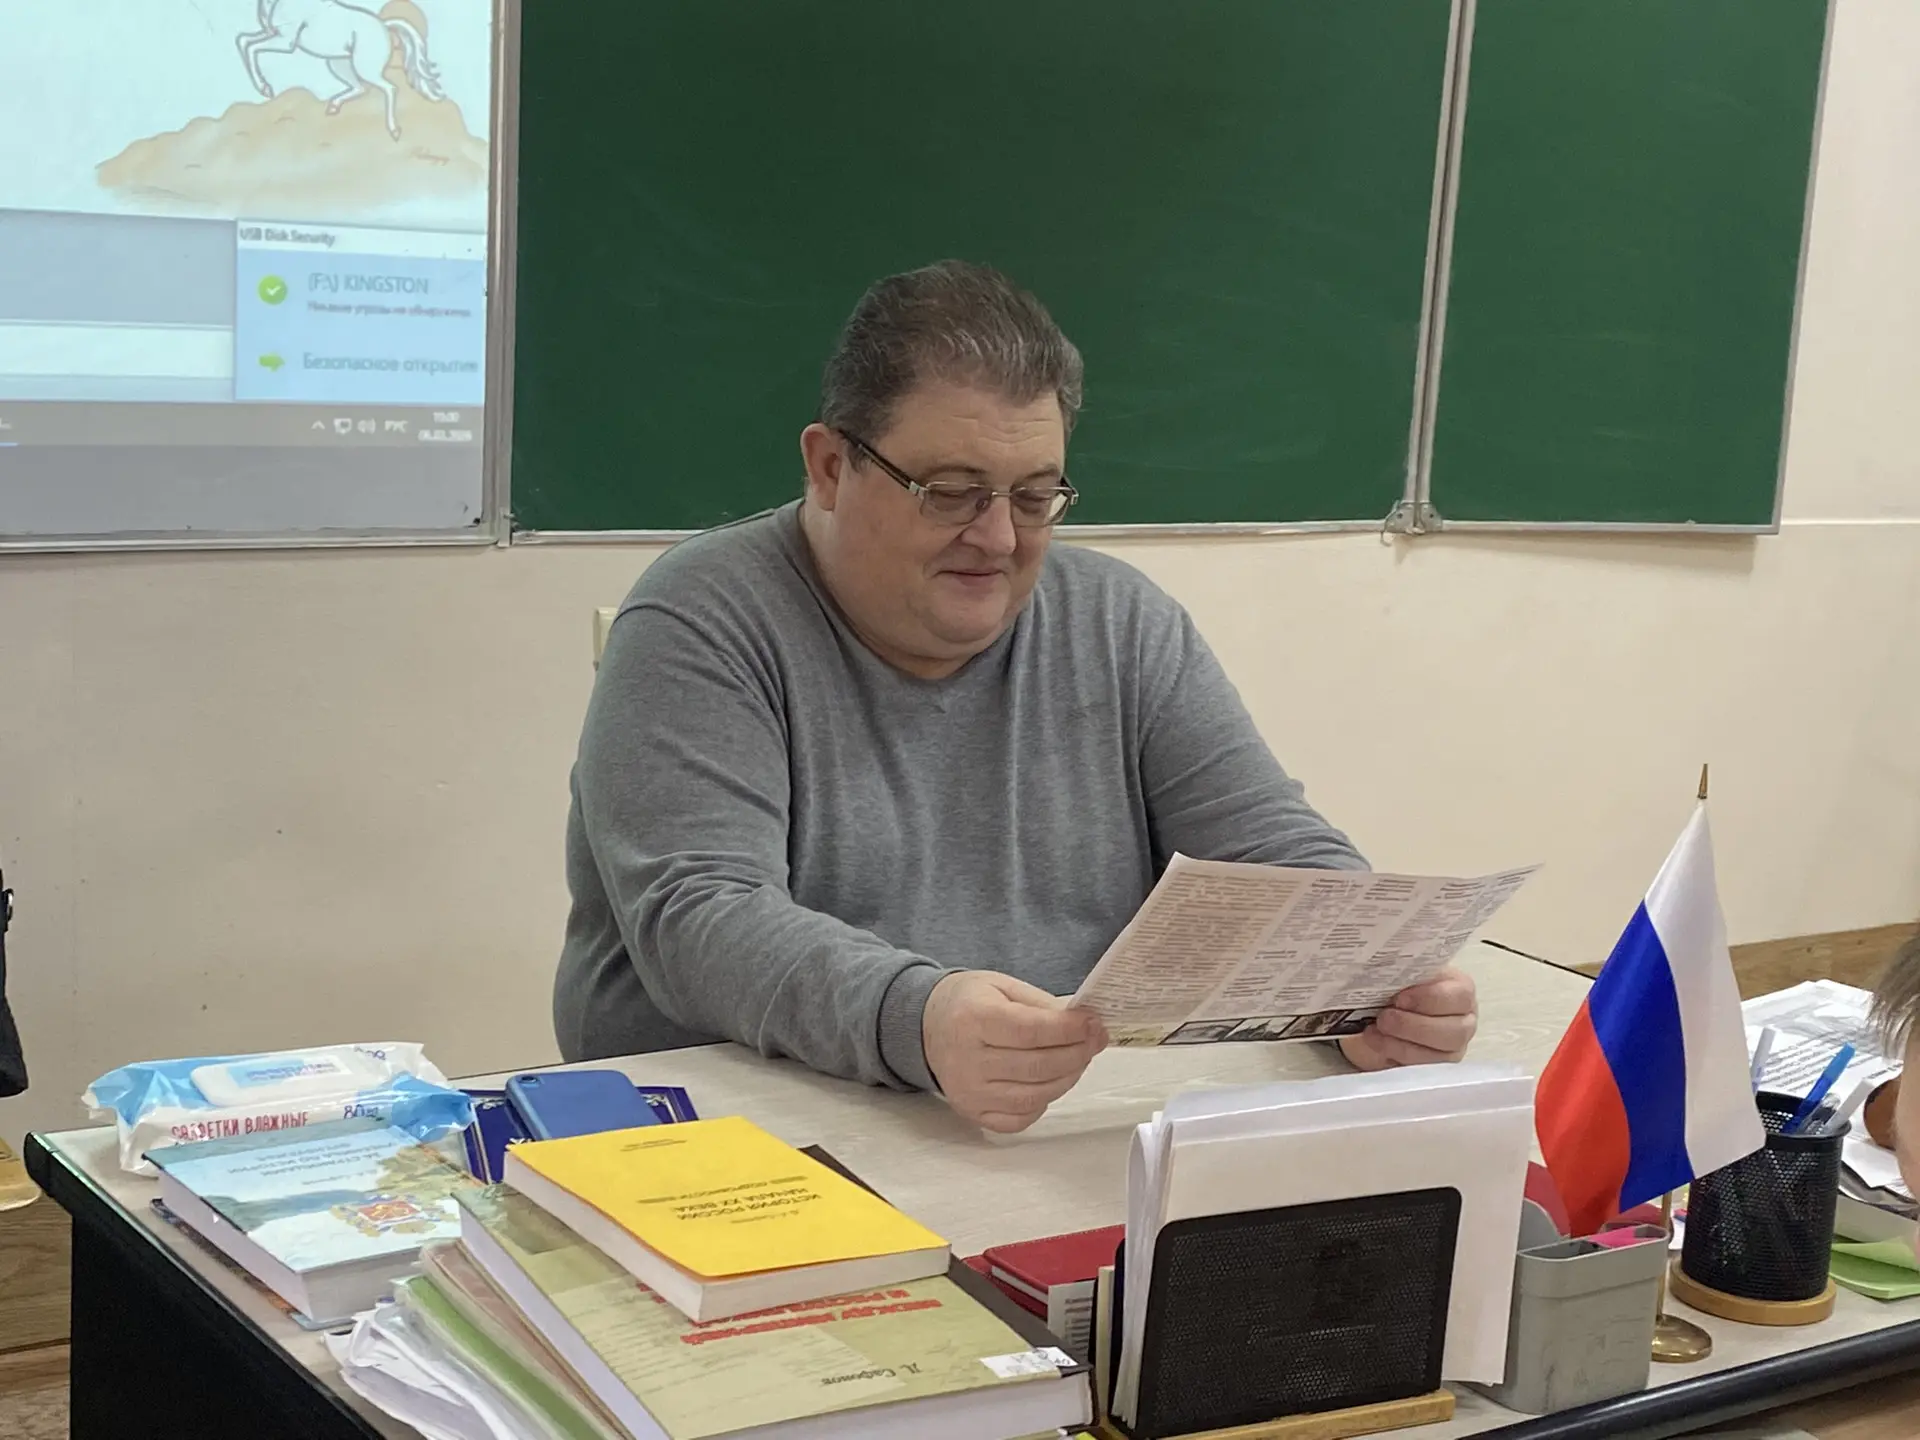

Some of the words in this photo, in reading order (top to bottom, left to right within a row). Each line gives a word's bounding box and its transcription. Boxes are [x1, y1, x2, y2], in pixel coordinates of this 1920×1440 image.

[240, 227, 262, 241] USB
[265, 229, 290, 242] Disk
[291, 230, 335, 248] Security
[344, 275, 428, 294] KINGSTON
[303, 352, 399, 372] Безопасное
[403, 356, 478, 376] открытие
[743, 1187, 808, 1202] НАЧАЛА
[746, 1193, 821, 1210] ИСТОРИЯ
[677, 1204, 744, 1220] РОССИИ
